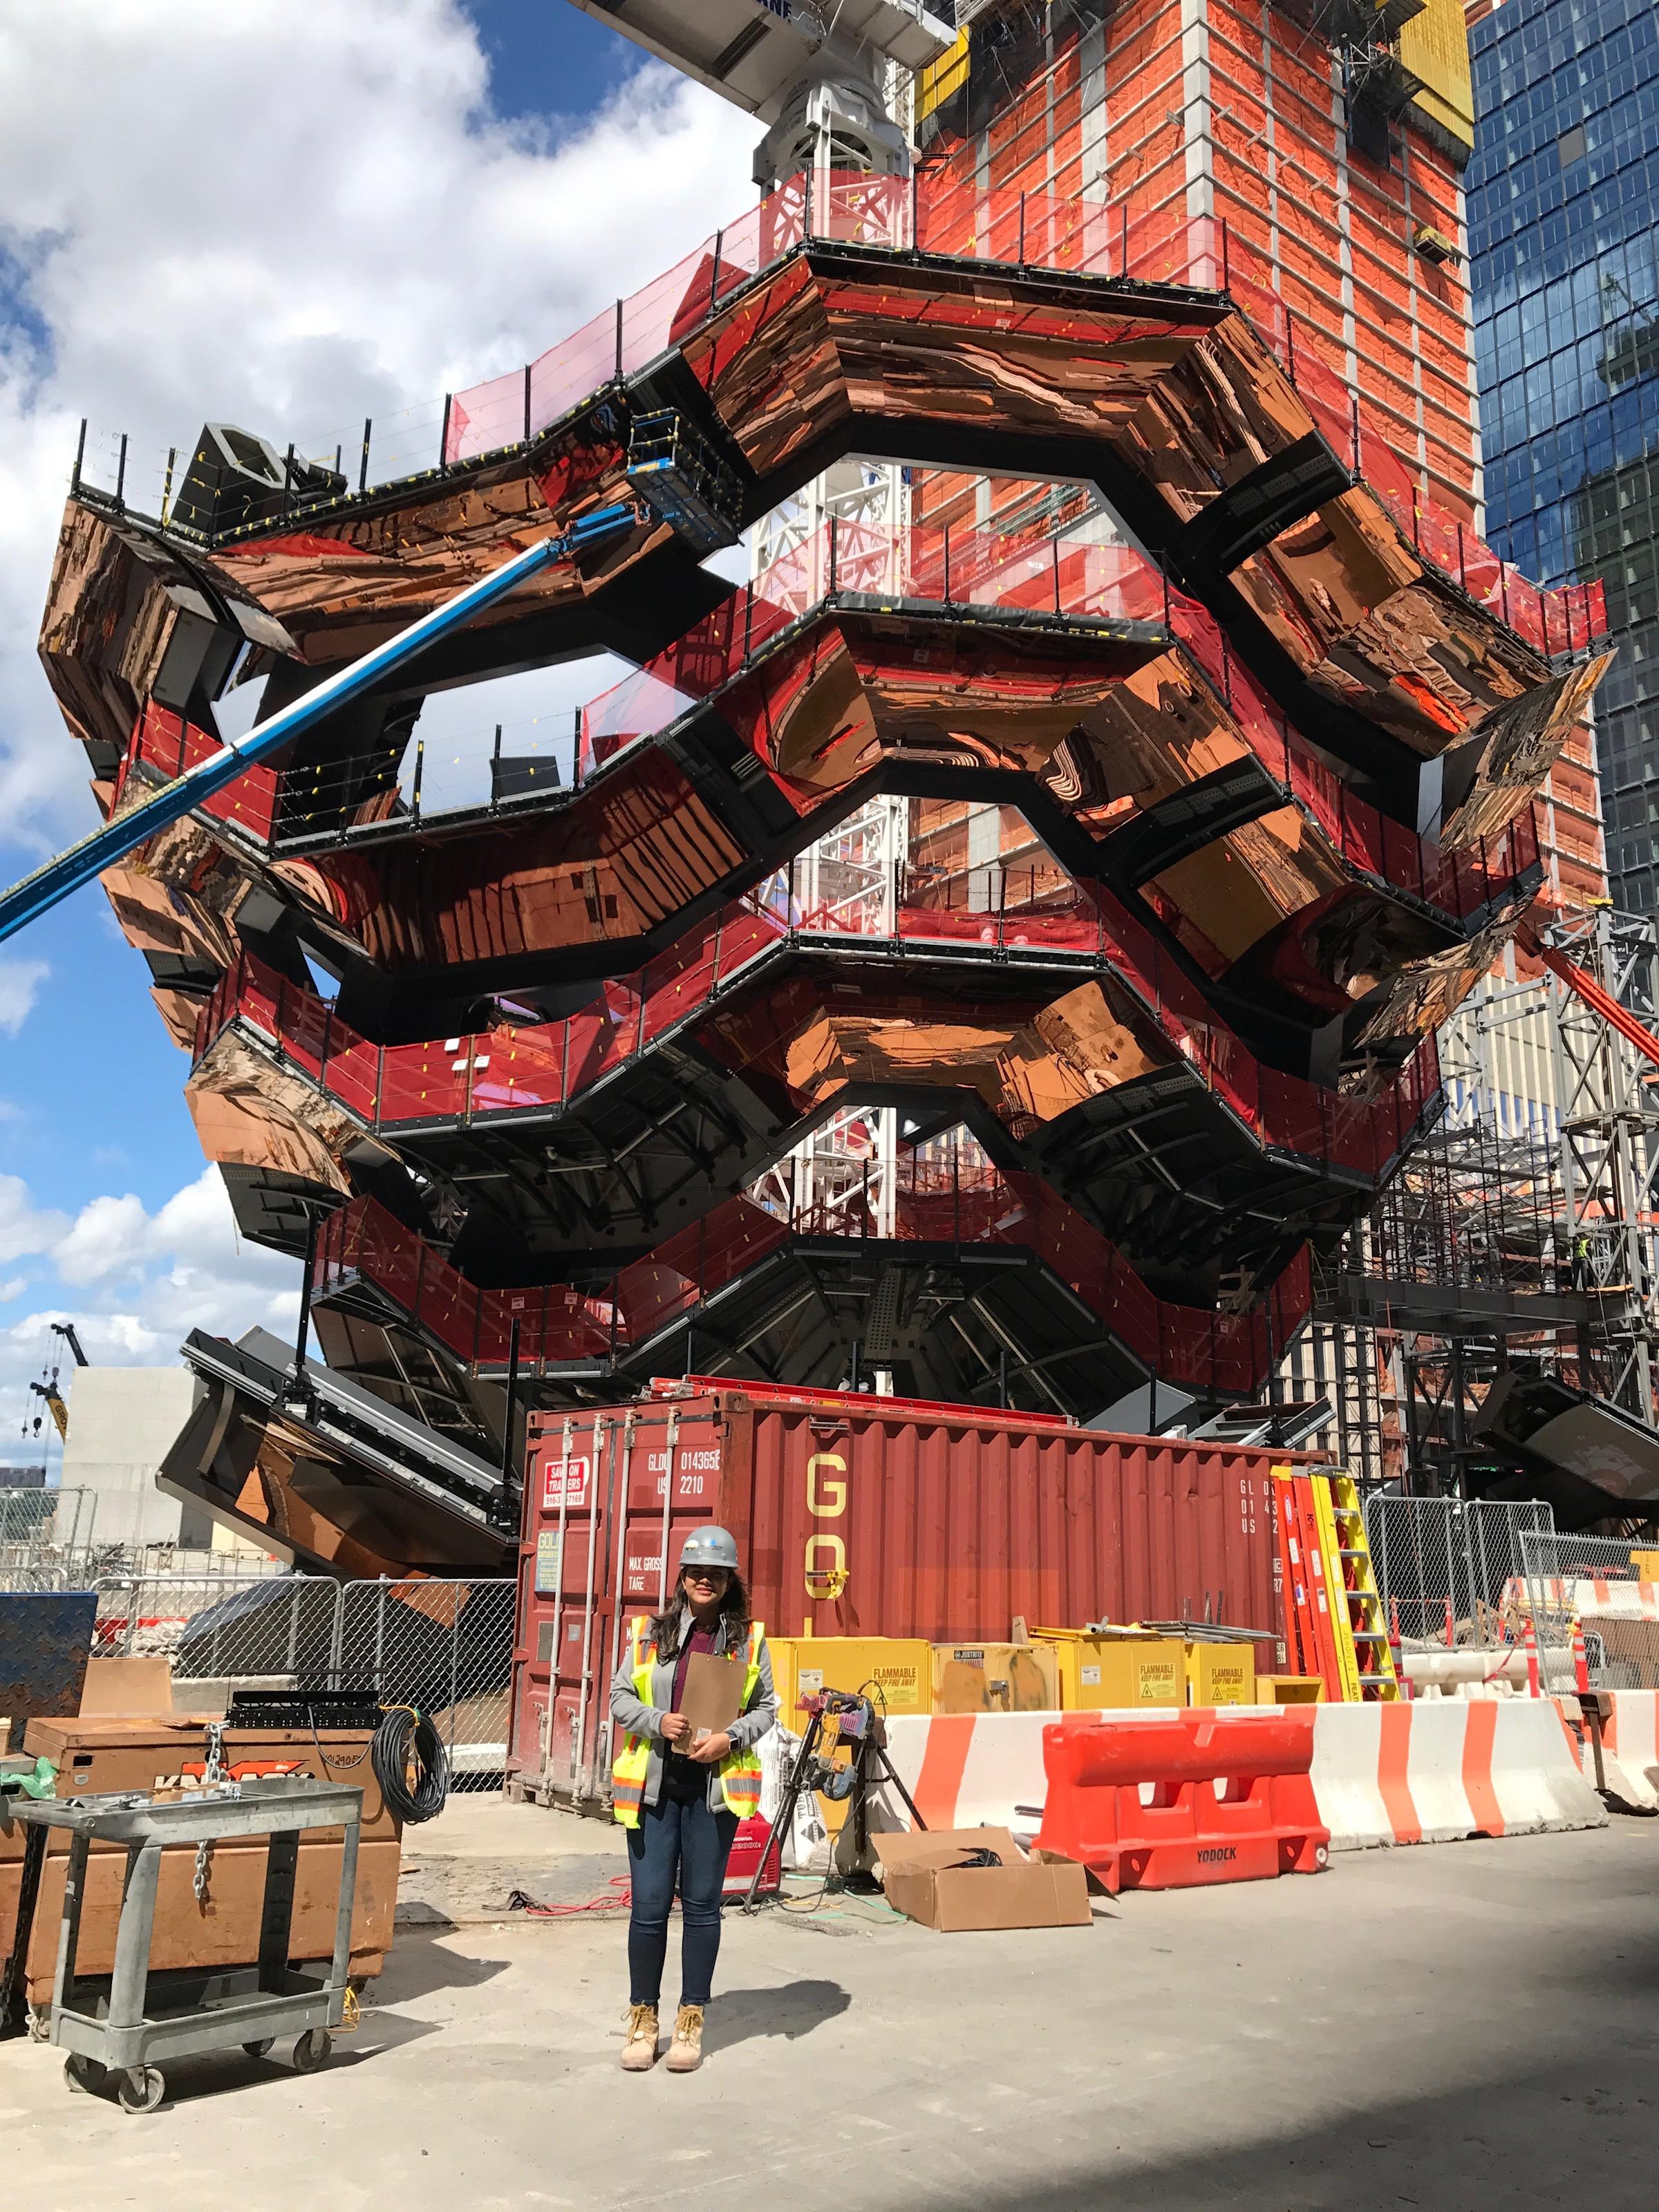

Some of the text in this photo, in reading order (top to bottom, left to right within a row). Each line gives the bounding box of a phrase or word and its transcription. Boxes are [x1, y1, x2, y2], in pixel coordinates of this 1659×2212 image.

[551, 1464, 580, 1479] SAV ON
[549, 1478, 581, 1492] TRAERS
[679, 1476, 704, 1493] 2210
[1241, 1518, 1255, 1533] US
[629, 1557, 663, 1571] MAX. GROSS
[628, 1576, 645, 1590] TARE
[960, 1651, 983, 1659] JUSTRITE
[874, 1667, 917, 1680] FLAMMABLE
[1141, 1664, 1174, 1674] FLAMMABLE
[1212, 1668, 1244, 1678] FLAMMABLE
[1197, 1846, 1236, 1863] YODOCK
